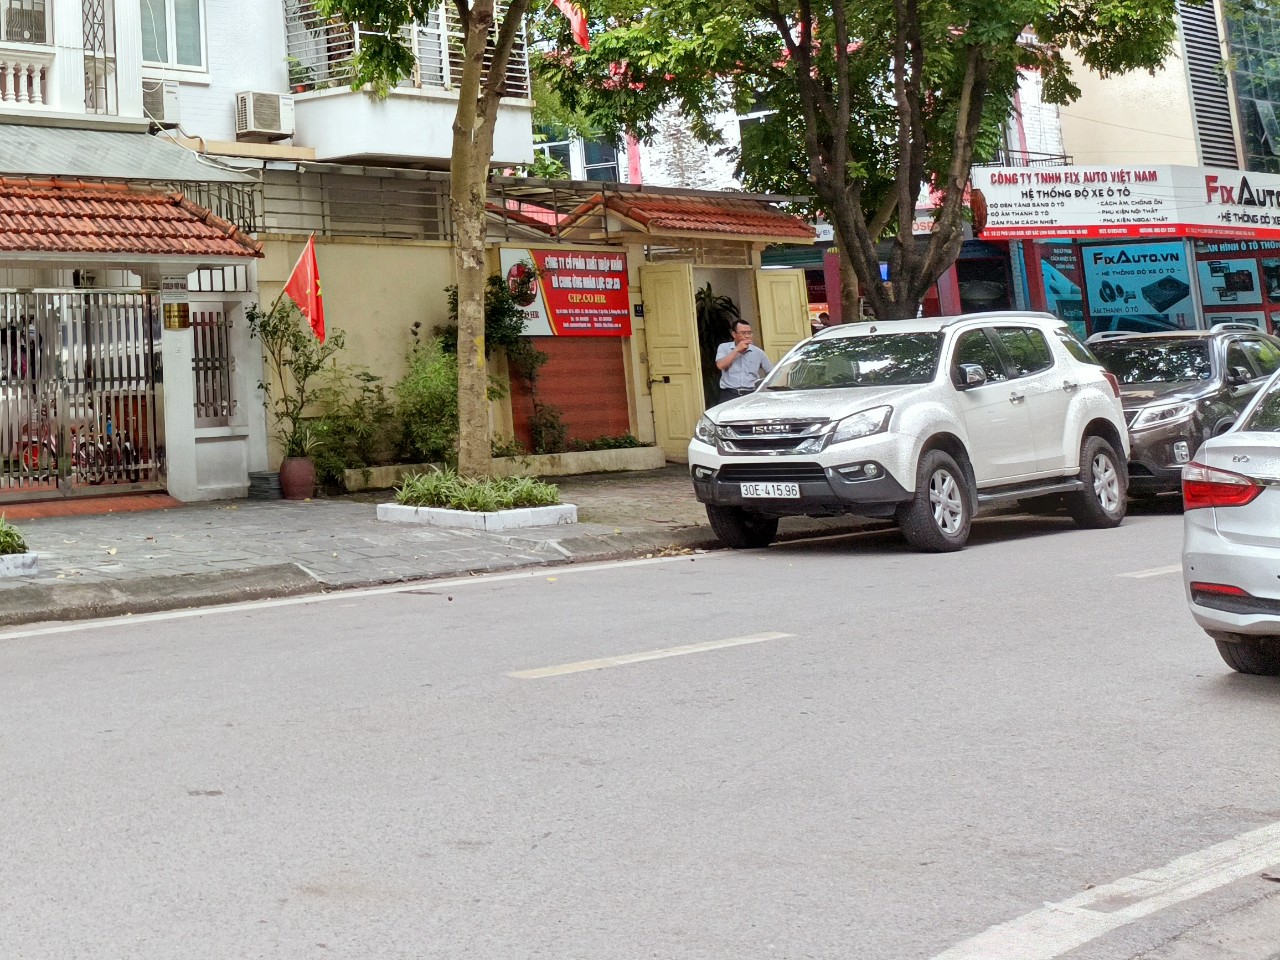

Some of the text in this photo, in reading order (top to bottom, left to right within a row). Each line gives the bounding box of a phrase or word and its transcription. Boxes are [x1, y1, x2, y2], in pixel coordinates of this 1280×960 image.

[990, 169, 1157, 184] CÔNG TY TNHH FIX AUTO VIỆT NAM
[1021, 186, 1131, 201] HỆ THỐNG ĐỘ XE Ô TÔ
[1221, 210, 1231, 224] HỆ
[1233, 209, 1258, 223] THỐNG
[1220, 241, 1239, 252] HÌNH
[1241, 241, 1246, 250] Ô
[1248, 241, 1258, 250] TÔ
[594, 294, 606, 303] HR
[752, 424, 790, 434] ISUZU
